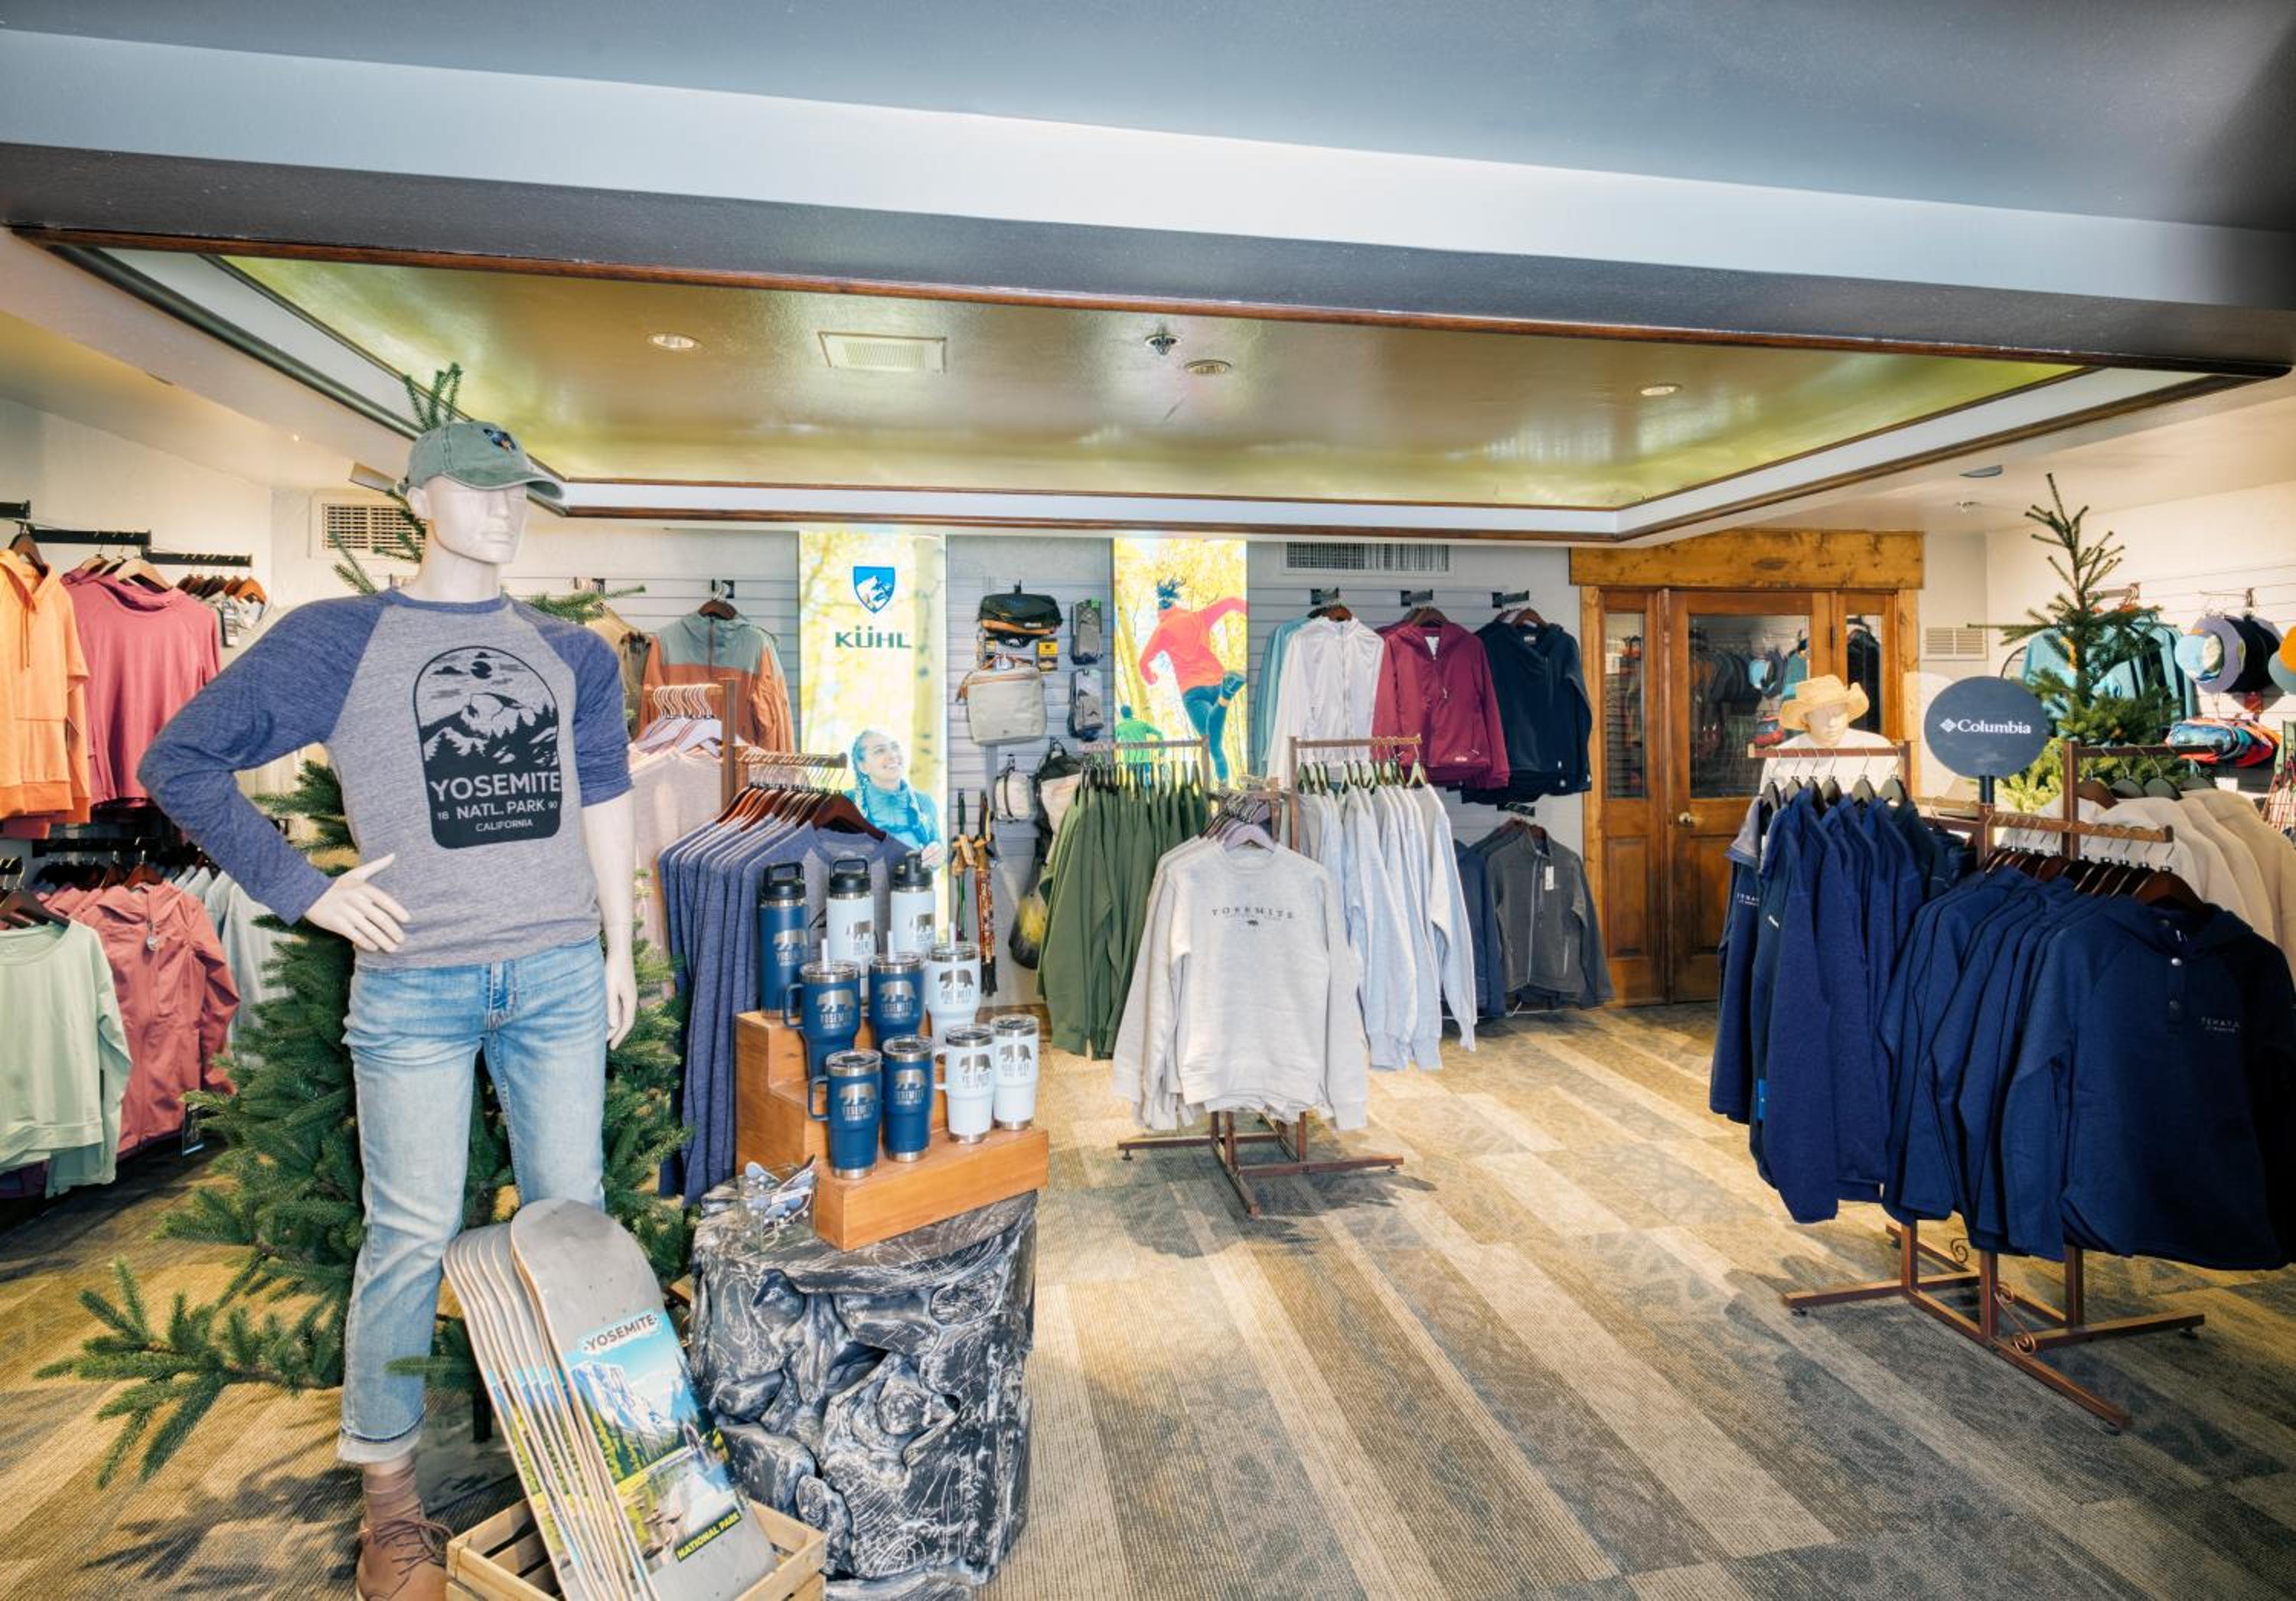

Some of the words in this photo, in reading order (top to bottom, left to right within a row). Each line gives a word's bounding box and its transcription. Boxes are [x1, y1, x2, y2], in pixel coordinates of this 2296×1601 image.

[834, 624, 913, 649] KÜHL
[1957, 719, 2032, 735] Columbia
[430, 771, 562, 802] YOSEMITE
[456, 804, 504, 820] NATL.
[507, 798, 546, 814] PARK
[475, 818, 533, 833] CALIFORNIA
[586, 1314, 656, 1350] YOSEMITE
[677, 1525, 720, 1560] NATIONAL
[719, 1511, 740, 1531] PARK
